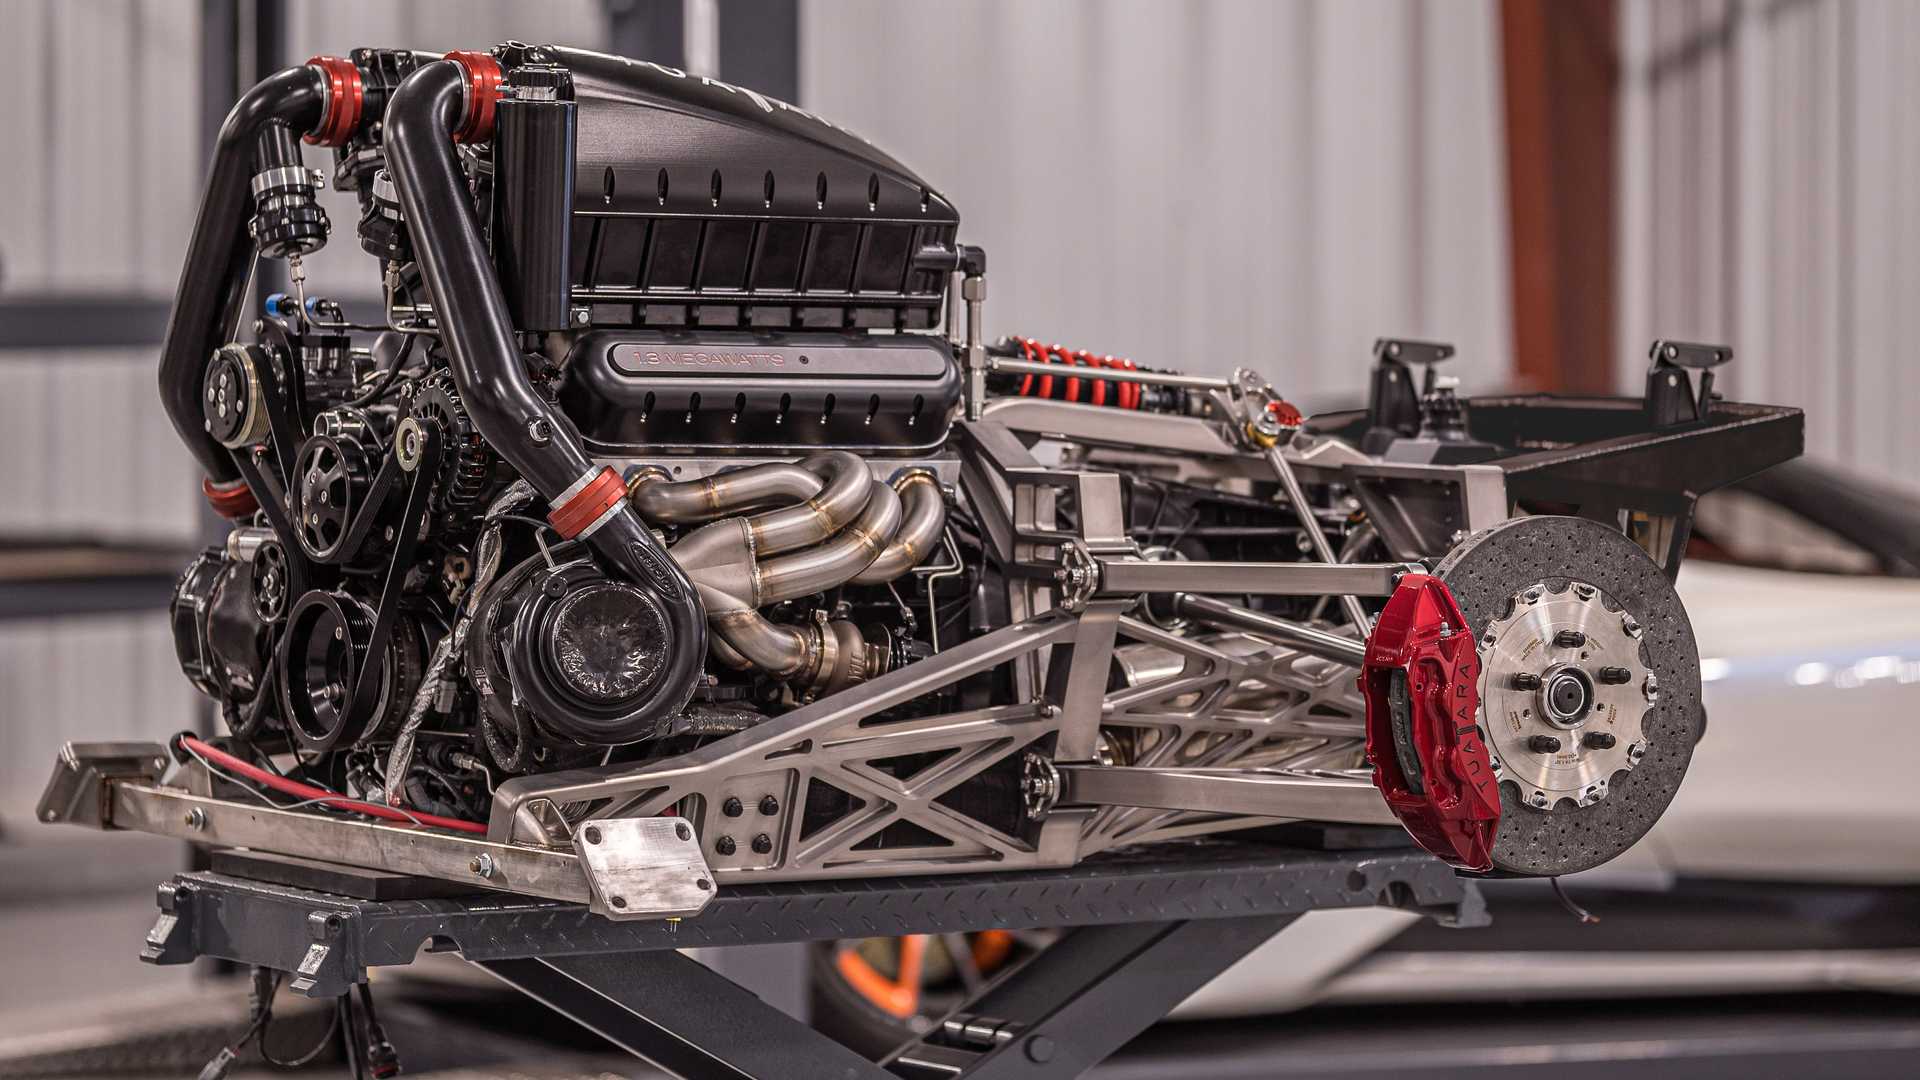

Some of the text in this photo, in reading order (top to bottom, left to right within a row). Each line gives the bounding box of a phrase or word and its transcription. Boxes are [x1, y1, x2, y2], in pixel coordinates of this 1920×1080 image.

[633, 352, 785, 368] 1.3 MEGAWATTS
[1453, 664, 1489, 793] TUATARA
